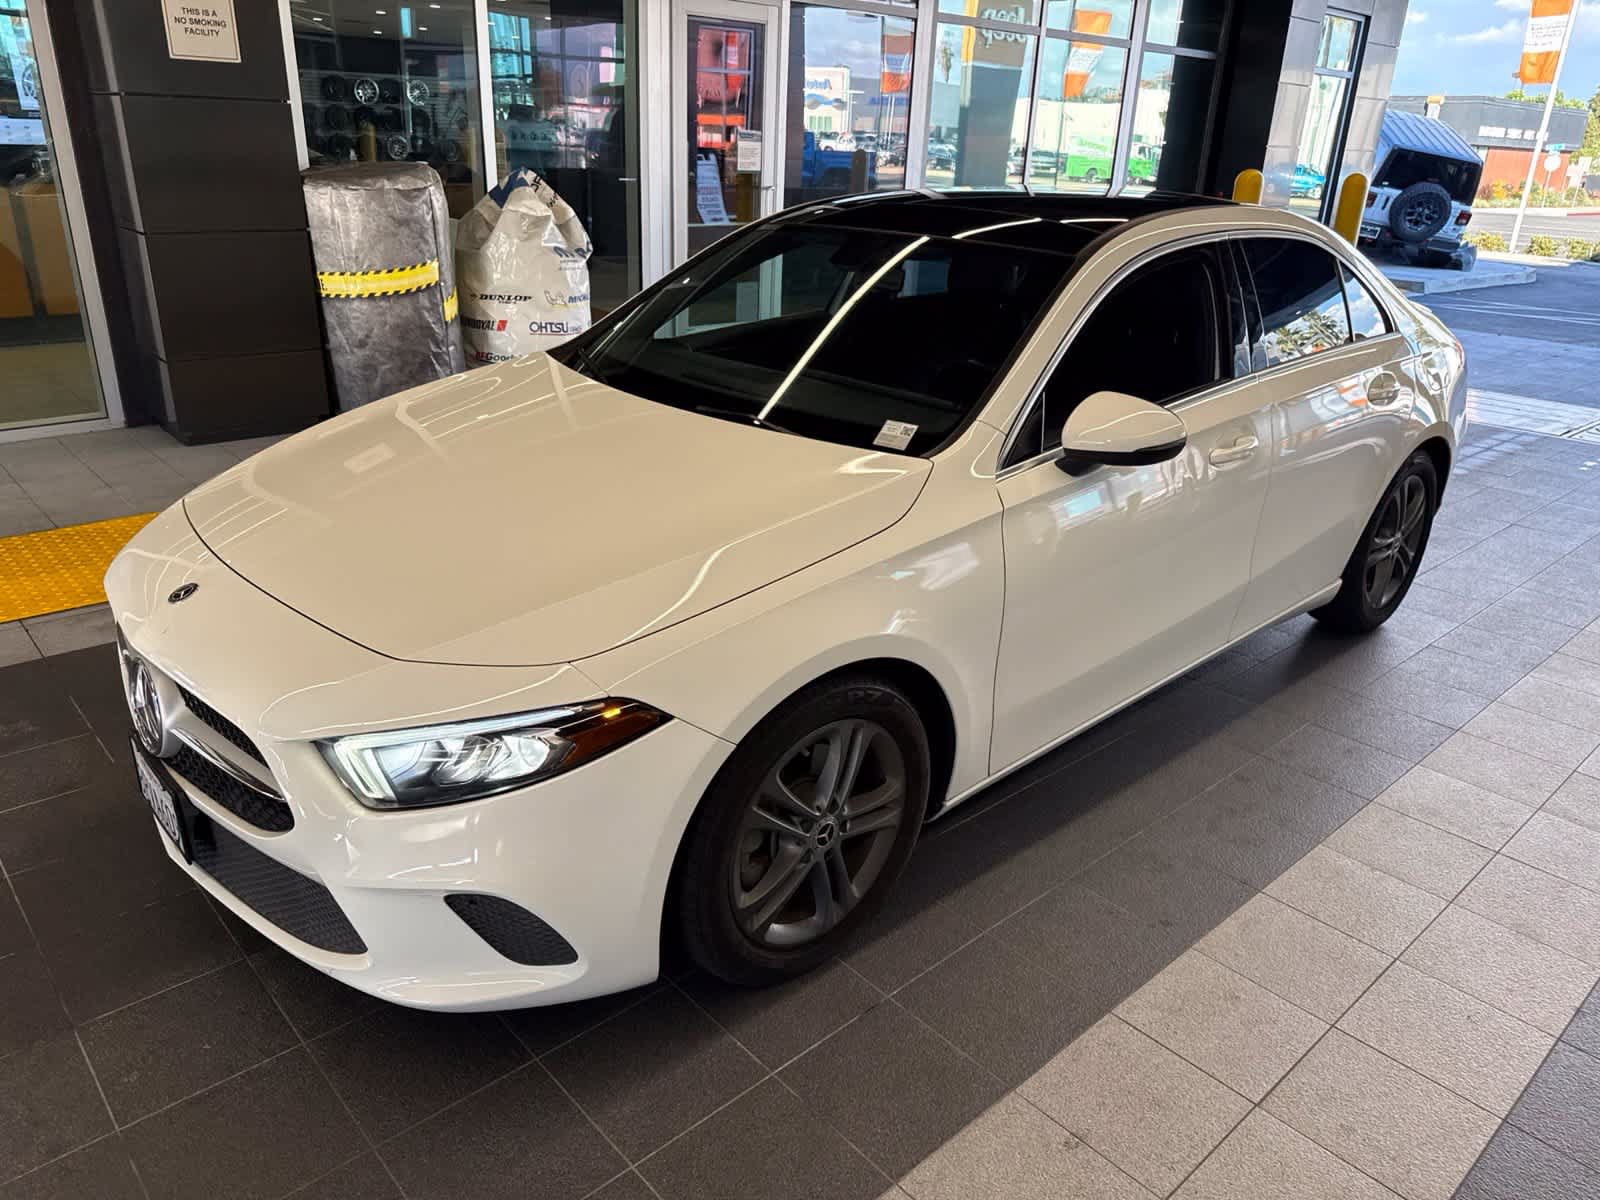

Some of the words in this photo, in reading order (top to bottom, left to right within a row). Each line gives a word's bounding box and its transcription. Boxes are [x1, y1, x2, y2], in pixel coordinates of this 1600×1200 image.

[181, 7, 200, 16] THIS
[202, 8, 210, 17] IS
[174, 16, 187, 25] NO
[188, 18, 227, 28] SMOKING
[184, 27, 219, 37] FACILITY
[479, 293, 533, 302] DUNLOP
[528, 321, 569, 334] OHTSU
